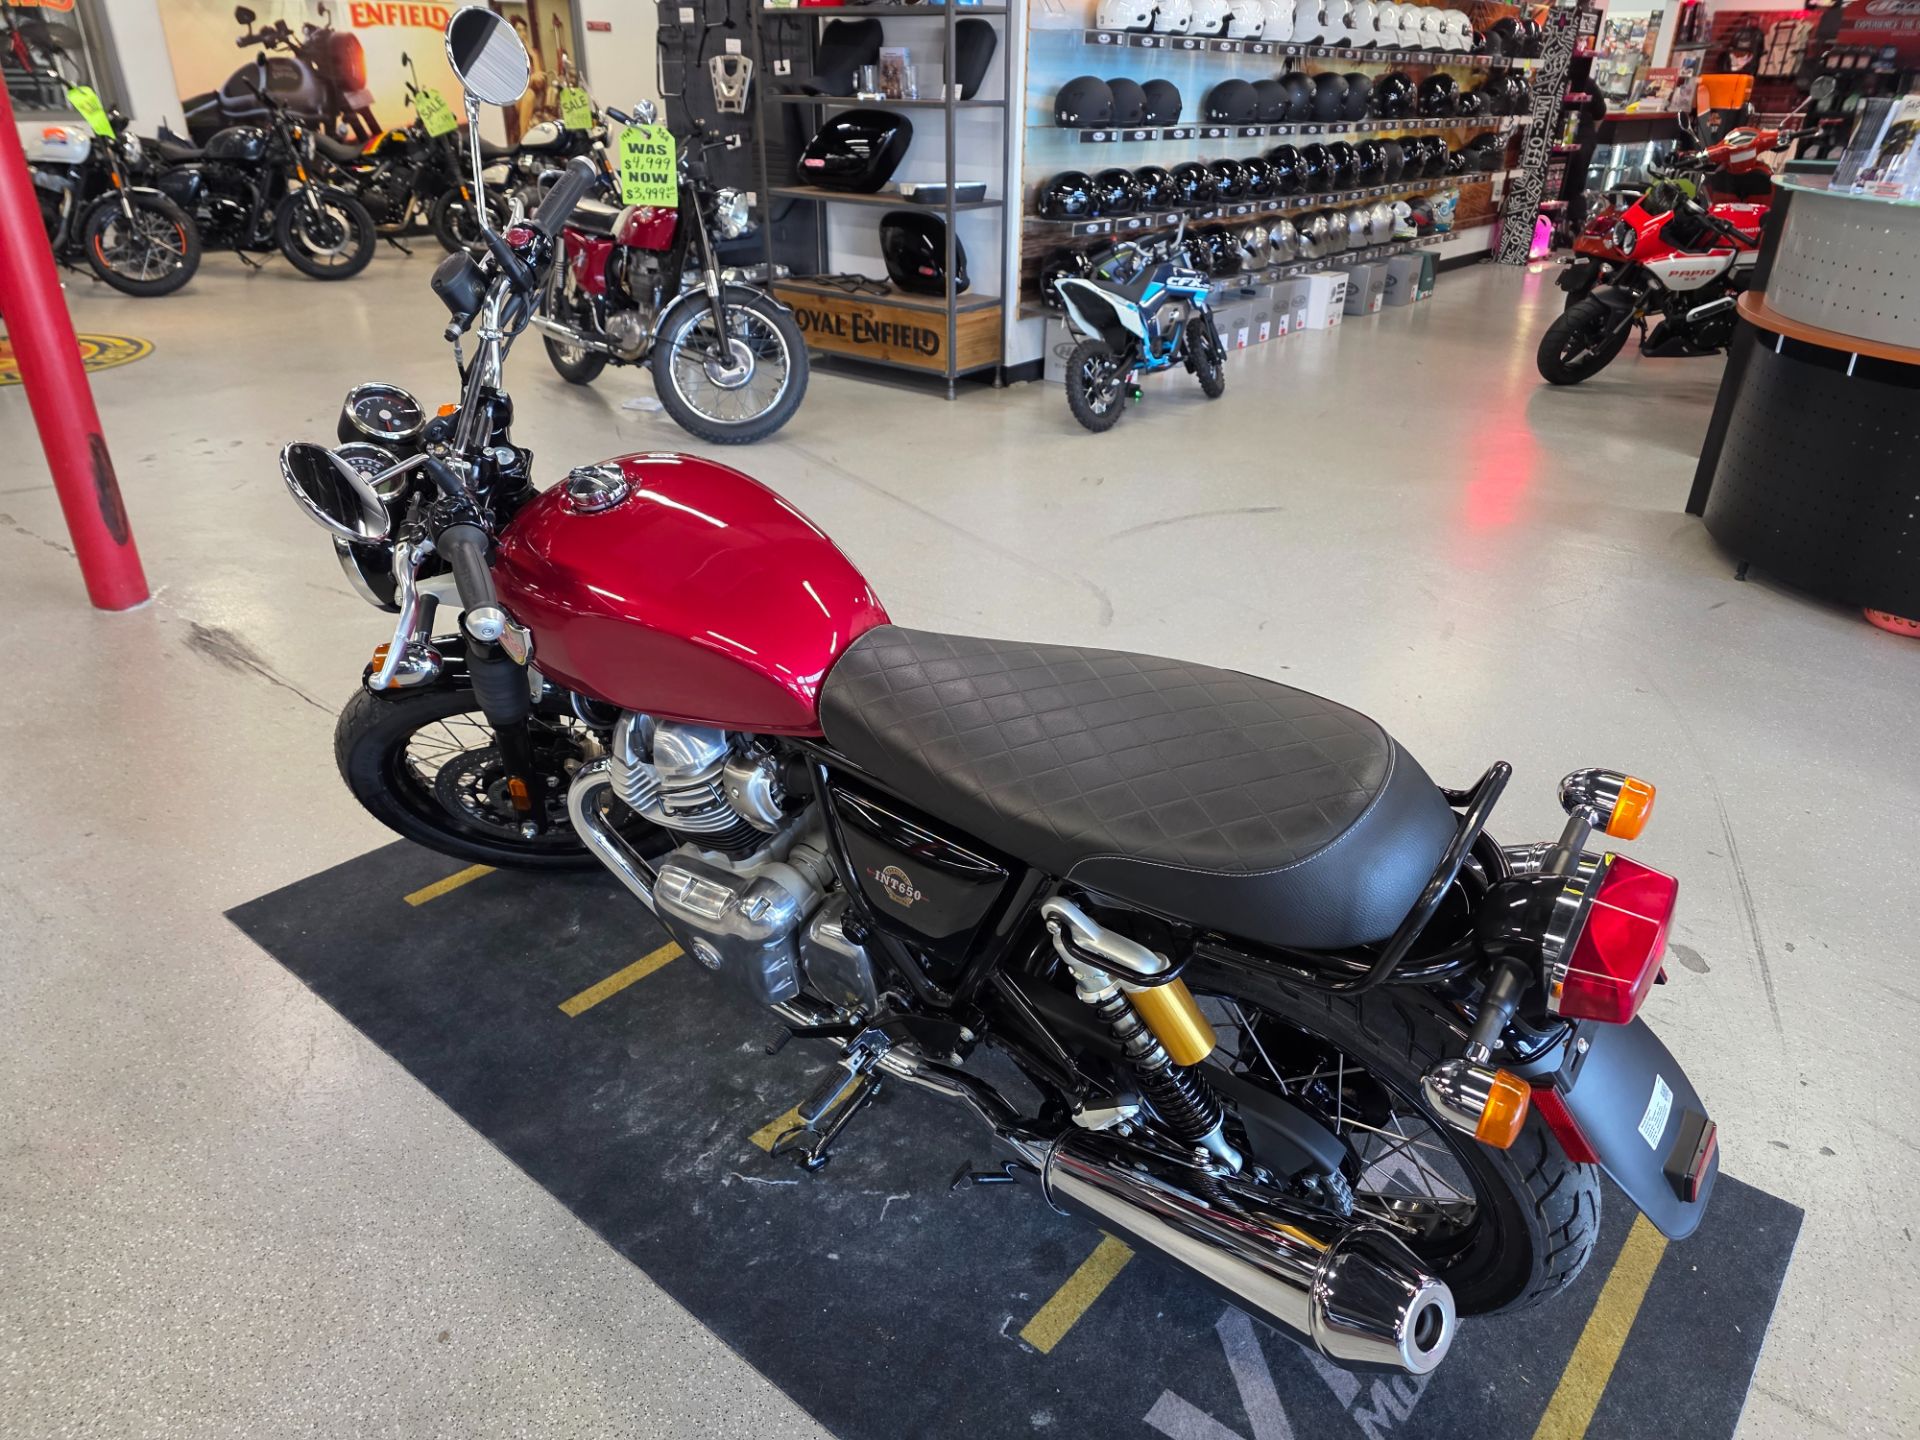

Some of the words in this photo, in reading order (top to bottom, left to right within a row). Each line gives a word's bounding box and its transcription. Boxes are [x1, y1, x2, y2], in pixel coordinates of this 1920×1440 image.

[349, 2, 450, 32] ENFIELD
[421, 95, 447, 120] SALE
[562, 95, 588, 114] SALE
[627, 142, 667, 155] WAS
[624, 156, 671, 170] $4,999
[628, 171, 669, 184] NOW
[1668, 268, 1717, 278] PAPIO
[851, 312, 940, 357] ENFIELD
[874, 869, 922, 901] INT650
